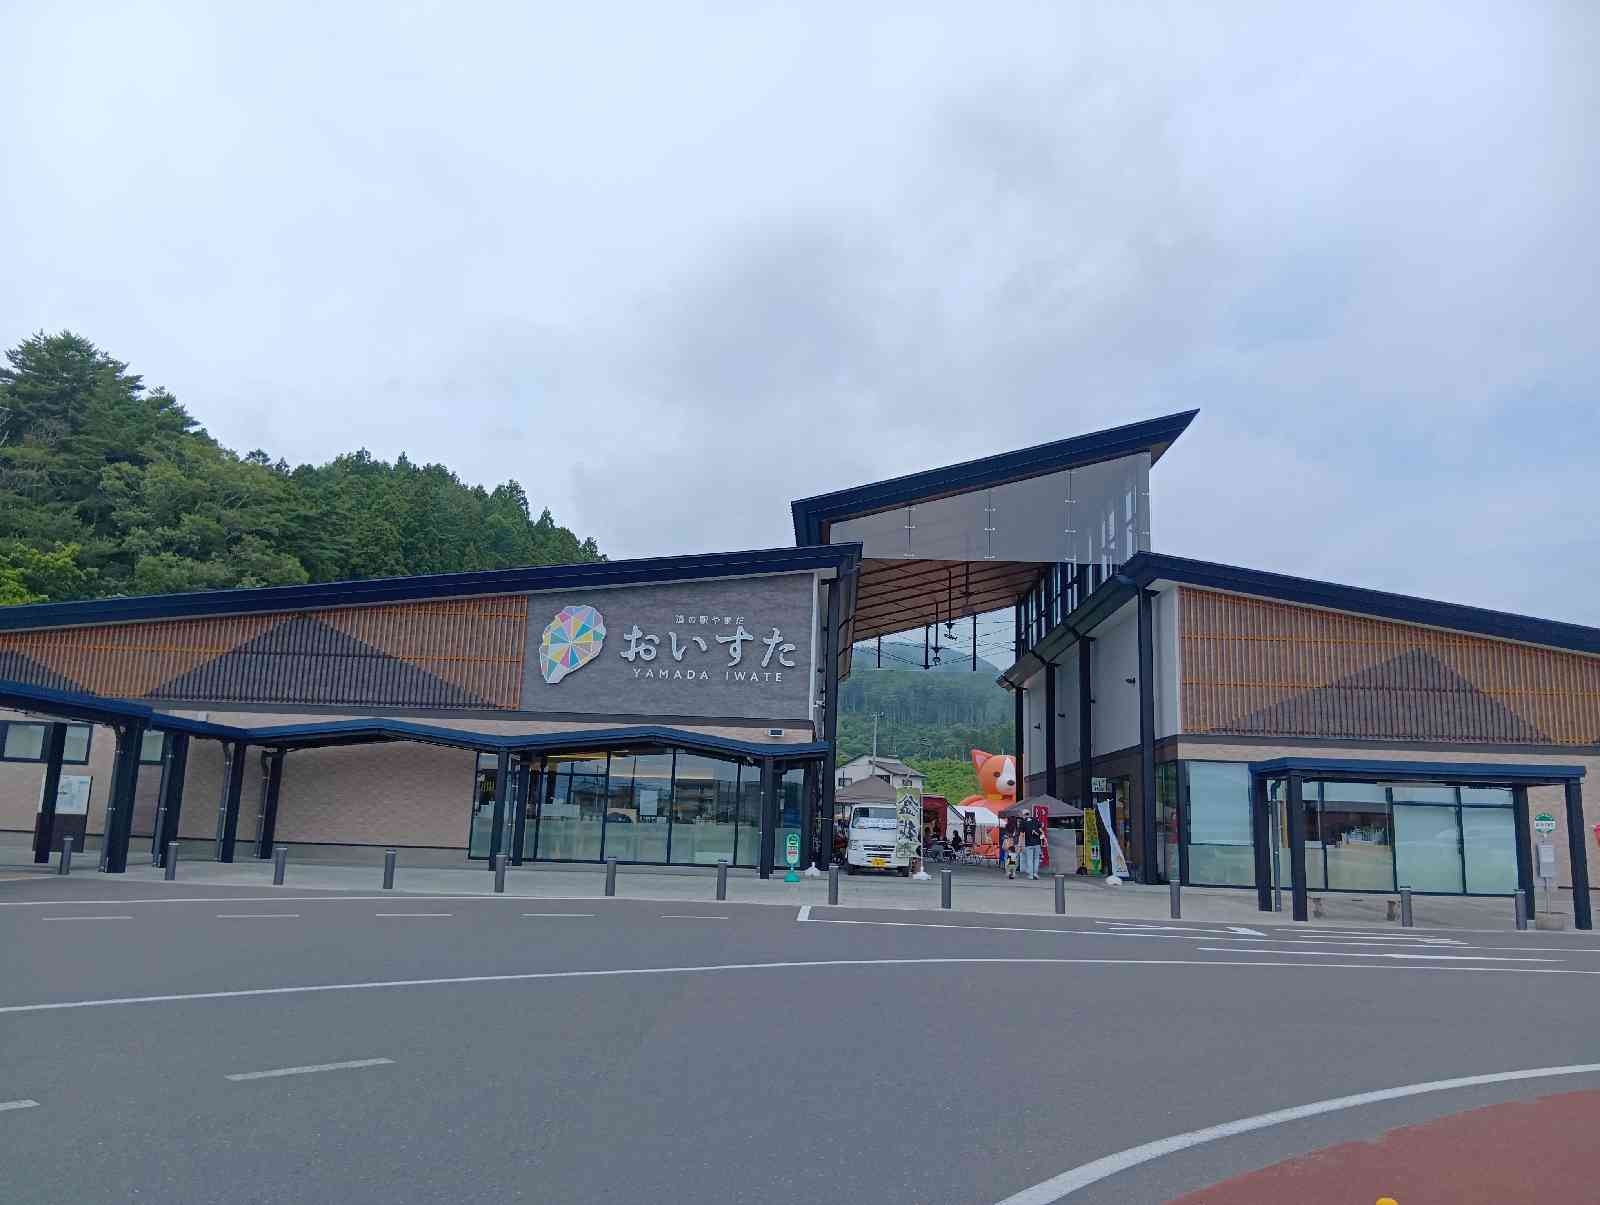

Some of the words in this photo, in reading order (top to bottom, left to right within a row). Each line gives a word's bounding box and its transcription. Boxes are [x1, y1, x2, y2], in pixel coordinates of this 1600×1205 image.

[674, 614, 745, 625] 道の駅やまだ
[619, 624, 796, 668] おいすた
[632, 668, 710, 681] YAMADA
[725, 671, 784, 682] IWATE
